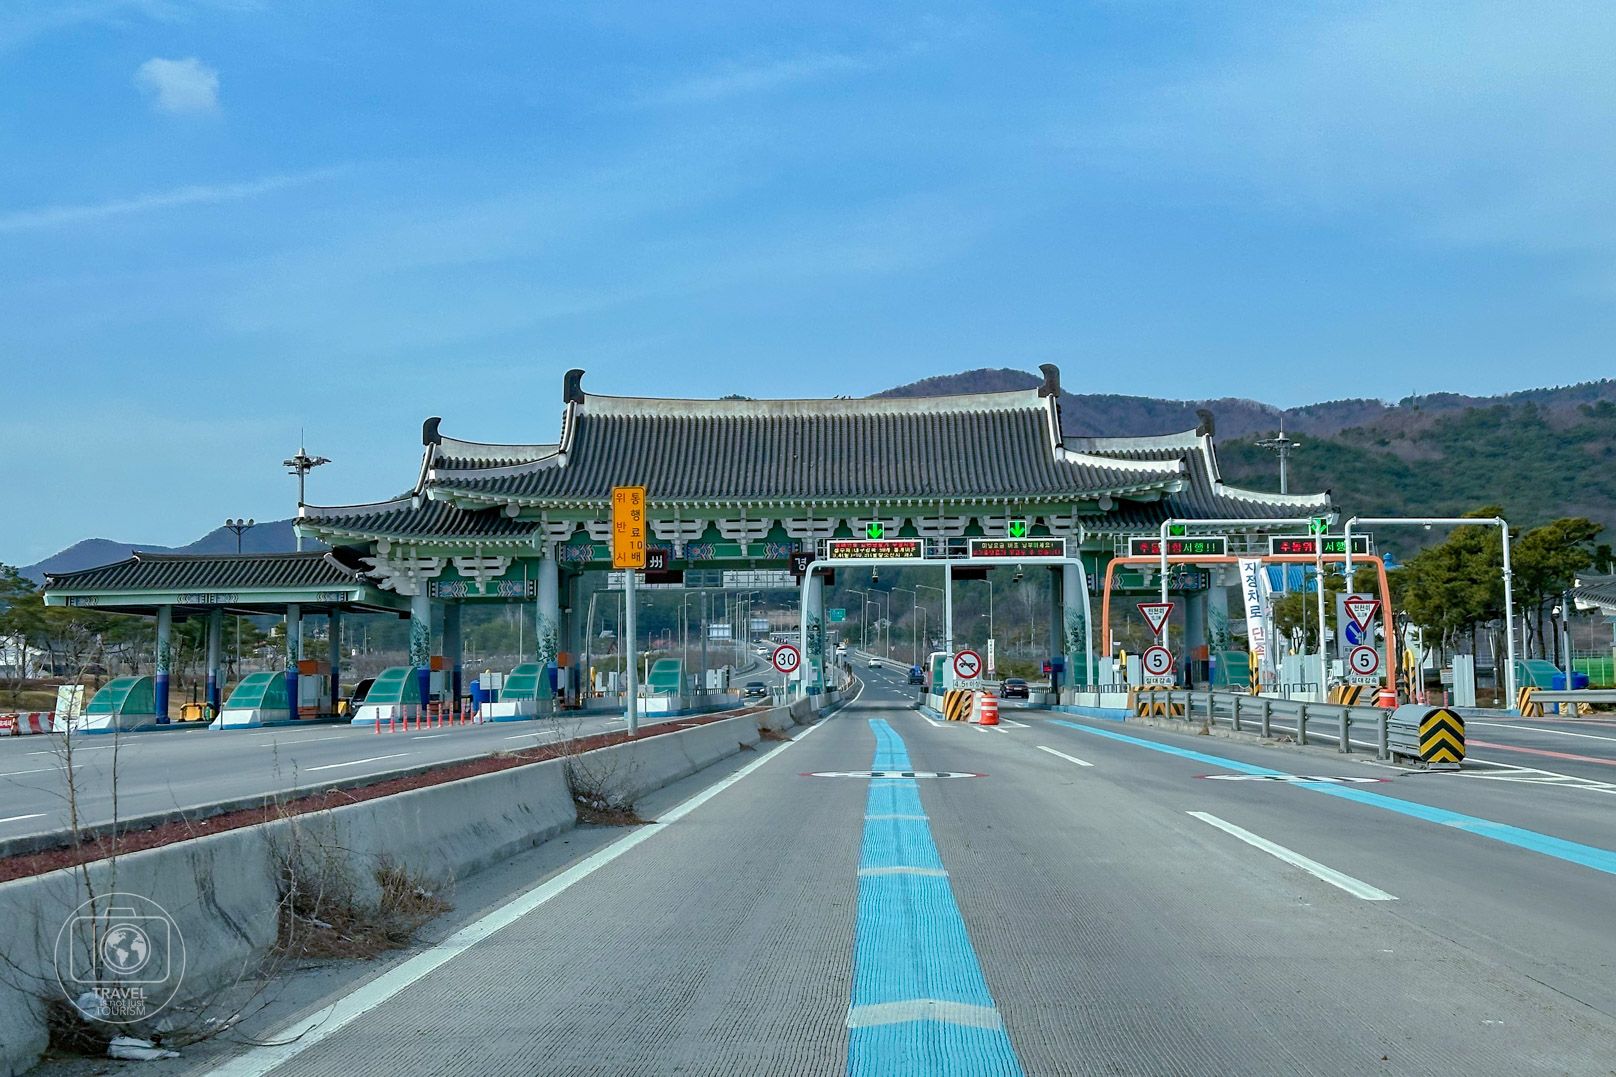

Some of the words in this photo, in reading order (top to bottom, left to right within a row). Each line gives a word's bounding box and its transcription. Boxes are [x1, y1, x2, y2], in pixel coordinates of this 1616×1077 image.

[1244, 562, 1263, 619] 지정차로
[778, 653, 795, 665] 30
[1153, 654, 1162, 667] 5
[1360, 654, 1369, 667] 5
